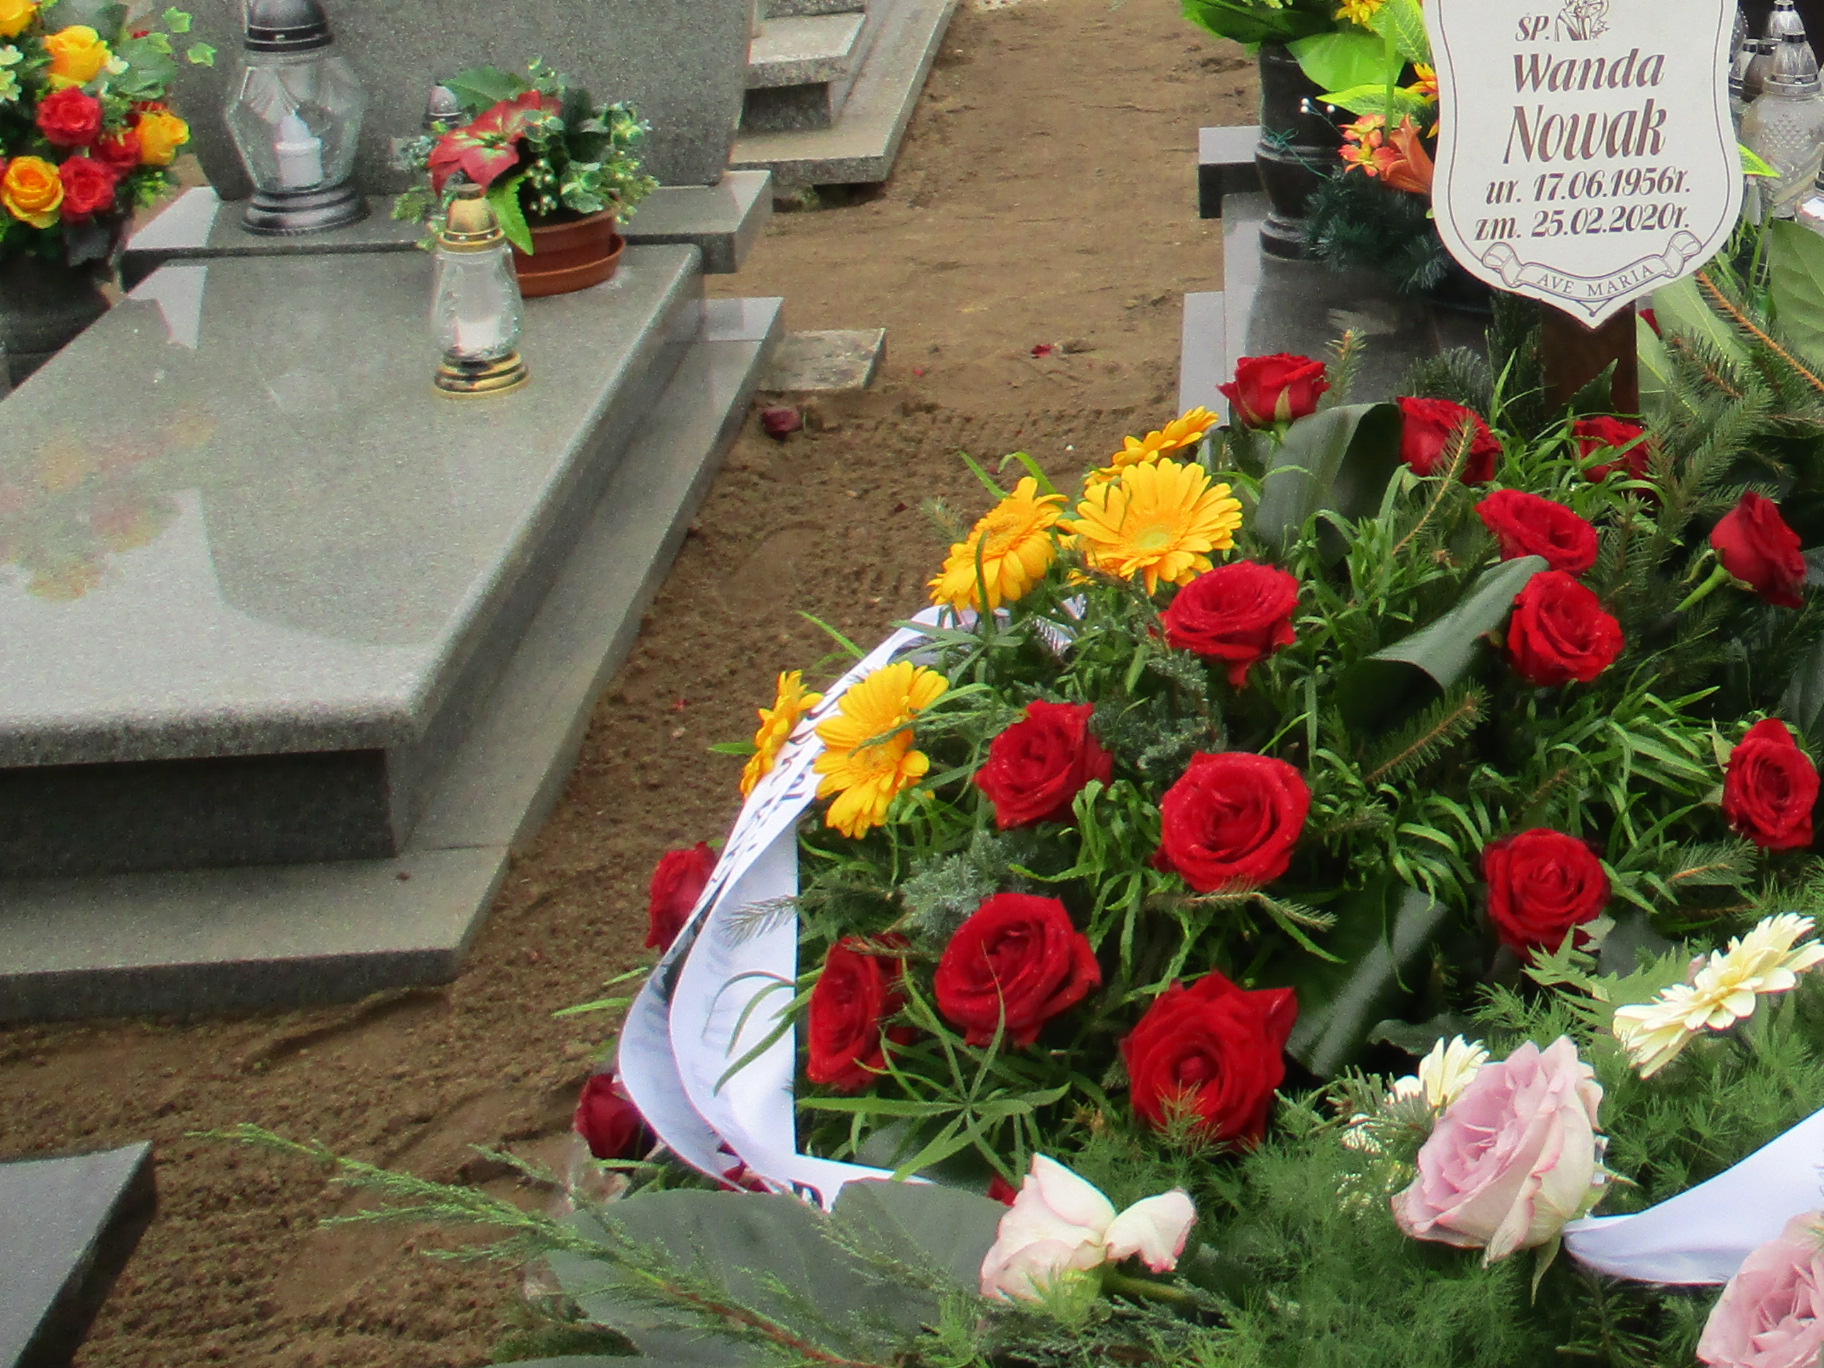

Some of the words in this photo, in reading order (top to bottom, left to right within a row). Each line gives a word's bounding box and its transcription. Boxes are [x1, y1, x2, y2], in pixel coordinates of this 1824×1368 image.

[1513, 48, 1665, 93] Wanda
[1503, 98, 1667, 164] Nowak
[1485, 181, 1522, 205] ur.
[1533, 166, 1691, 202] 17.06.1956r.
[1474, 216, 1522, 241] zm.
[1531, 203, 1690, 239] 25.02.2020r.
[1537, 273, 1575, 295] AVE
[1586, 264, 1655, 297] MARIA
